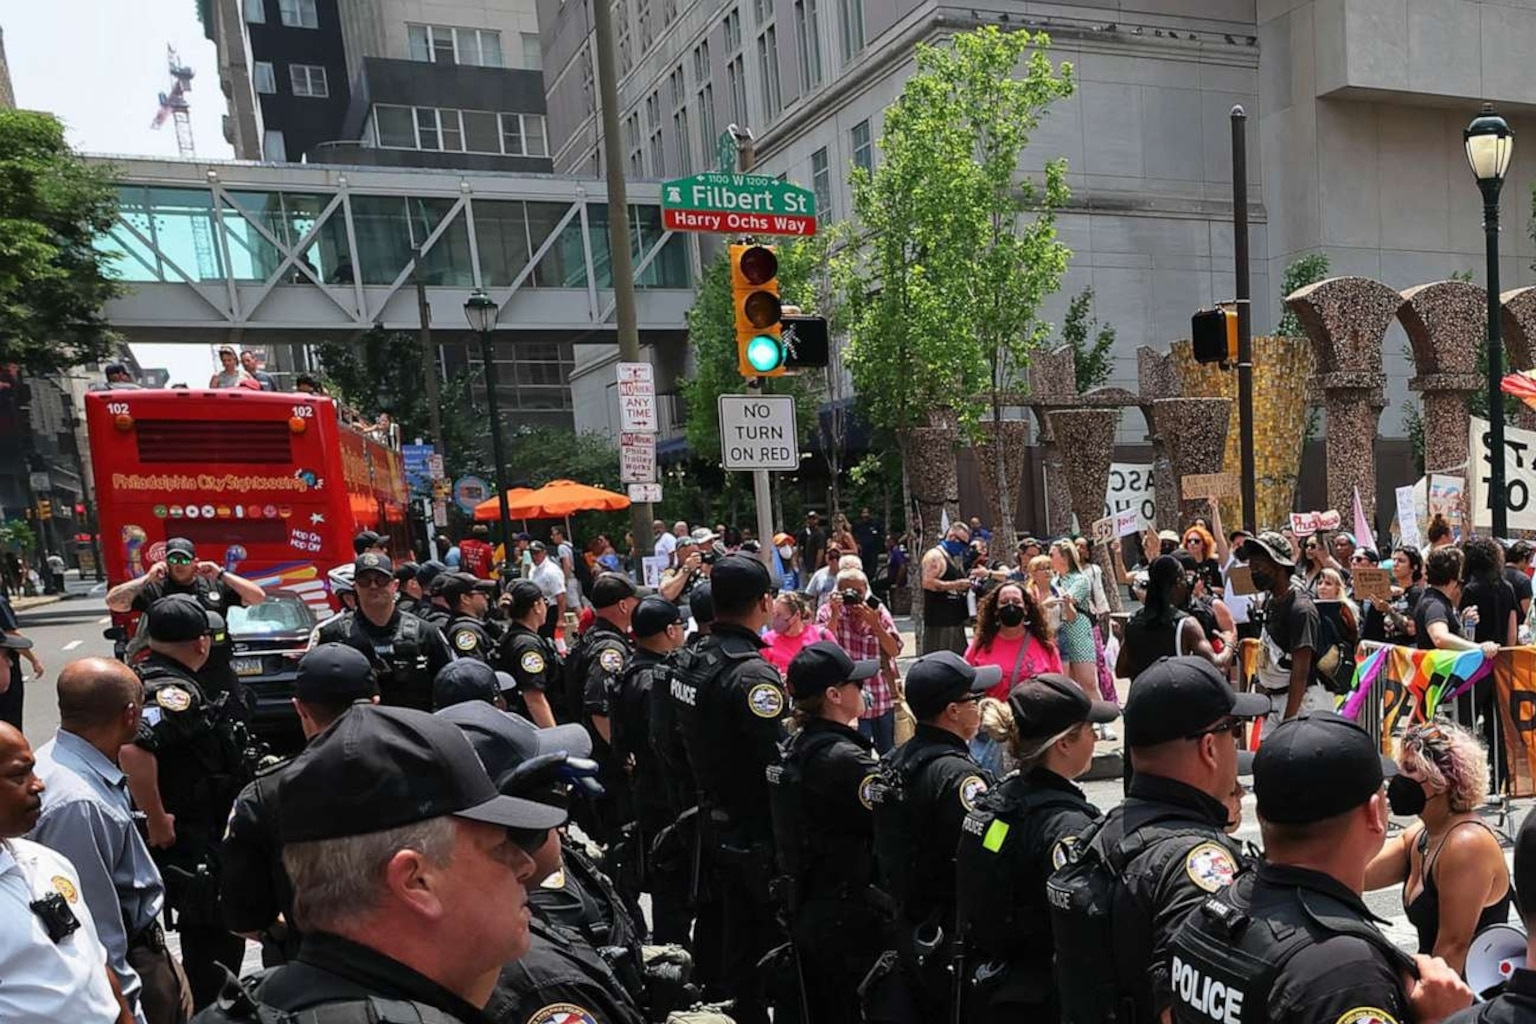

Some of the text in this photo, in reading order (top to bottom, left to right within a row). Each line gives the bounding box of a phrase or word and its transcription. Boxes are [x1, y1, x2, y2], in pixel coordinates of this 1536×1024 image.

[709, 174, 768, 187] 1100 W 1200
[692, 185, 807, 213] Filbert St
[675, 211, 806, 234] Harry Ochs Way
[107, 403, 129, 414] 102
[626, 398, 650, 407] ANY
[292, 406, 313, 417] 102
[627, 408, 651, 418] TIME
[744, 404, 770, 418] NO
[734, 426, 783, 440] TURN
[731, 447, 790, 461] ON RED
[292, 529, 305, 541] Hop
[290, 538, 304, 551] Hop
[670, 678, 697, 706] POLICE
